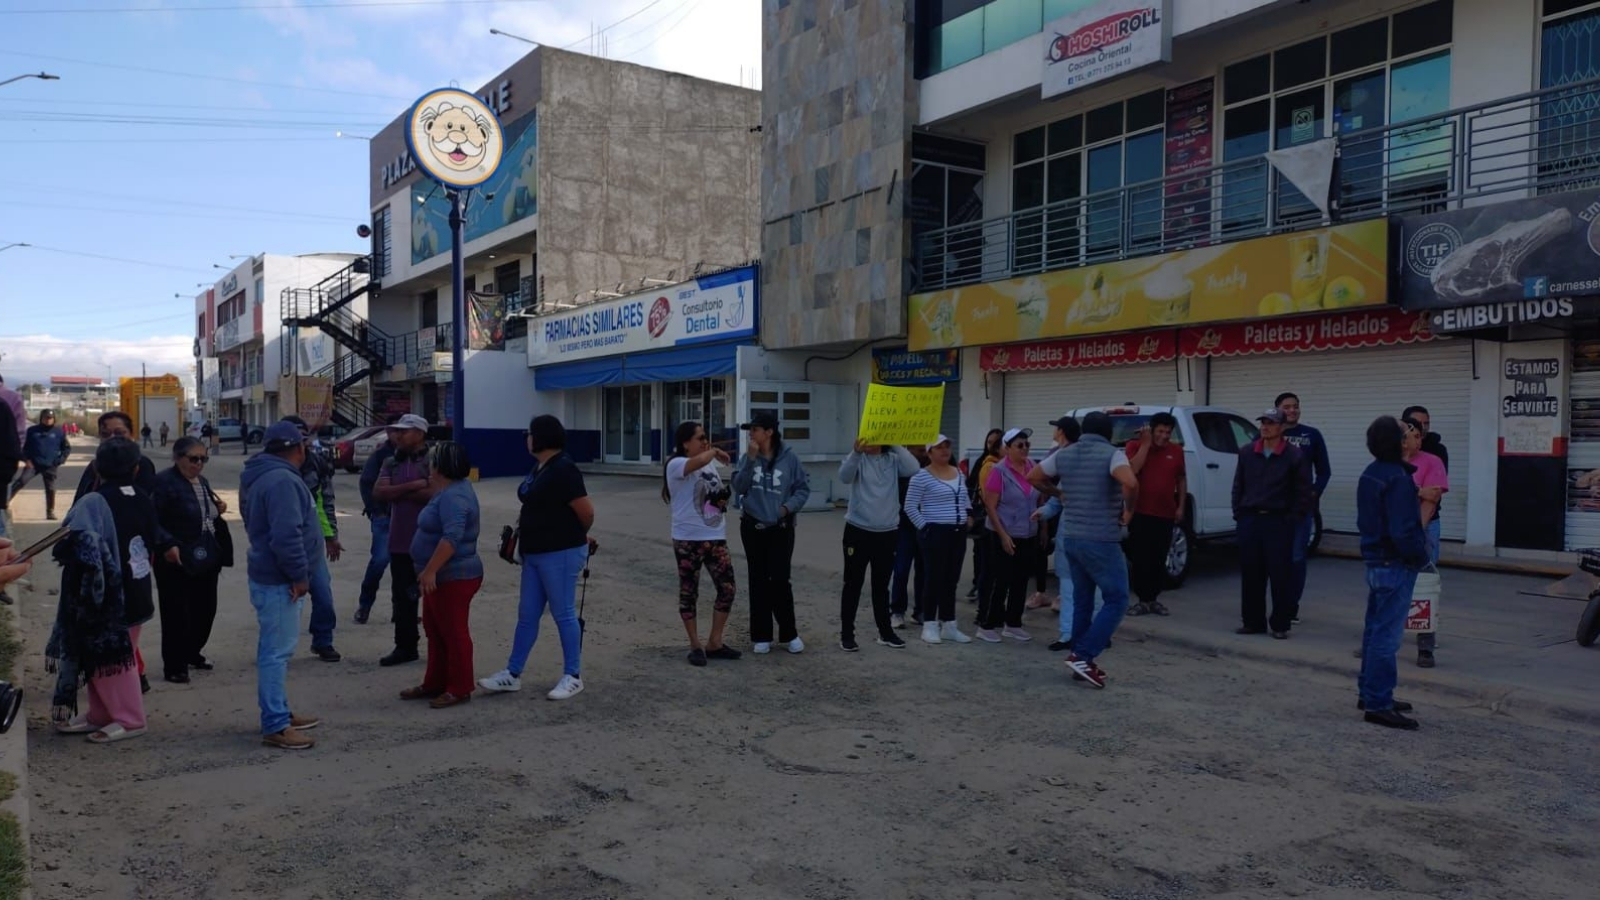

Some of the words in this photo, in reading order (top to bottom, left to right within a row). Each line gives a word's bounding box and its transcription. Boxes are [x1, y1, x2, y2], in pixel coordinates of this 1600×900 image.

[1068, 56, 1096, 73] Cocina
[1098, 42, 1132, 62] Oriental
[381, 150, 416, 189] PLAZA
[1420, 243, 1449, 258] TIF
[682, 298, 723, 316] Consultorio
[1443, 296, 1574, 330] EMBUTIDOS
[545, 313, 591, 343] FARMACIAS
[593, 302, 644, 334] SIMILARES
[686, 313, 720, 334] Dental
[1244, 322, 1302, 345] Paletas
[1305, 324, 1316, 344] y
[1320, 313, 1390, 339] Helados
[1024, 346, 1063, 363] Paletas
[1068, 348, 1075, 365] y
[1078, 340, 1125, 359] Helados
[1505, 361, 1558, 375] ESTAMOS
[871, 392, 898, 402] ESTE
[1516, 381, 1545, 395] PARA
[869, 406, 897, 416] LLEVA
[904, 405, 938, 416] MESES
[1504, 400, 1557, 413] SERVIRTE
[867, 419, 936, 431] INTRANSITABLE
